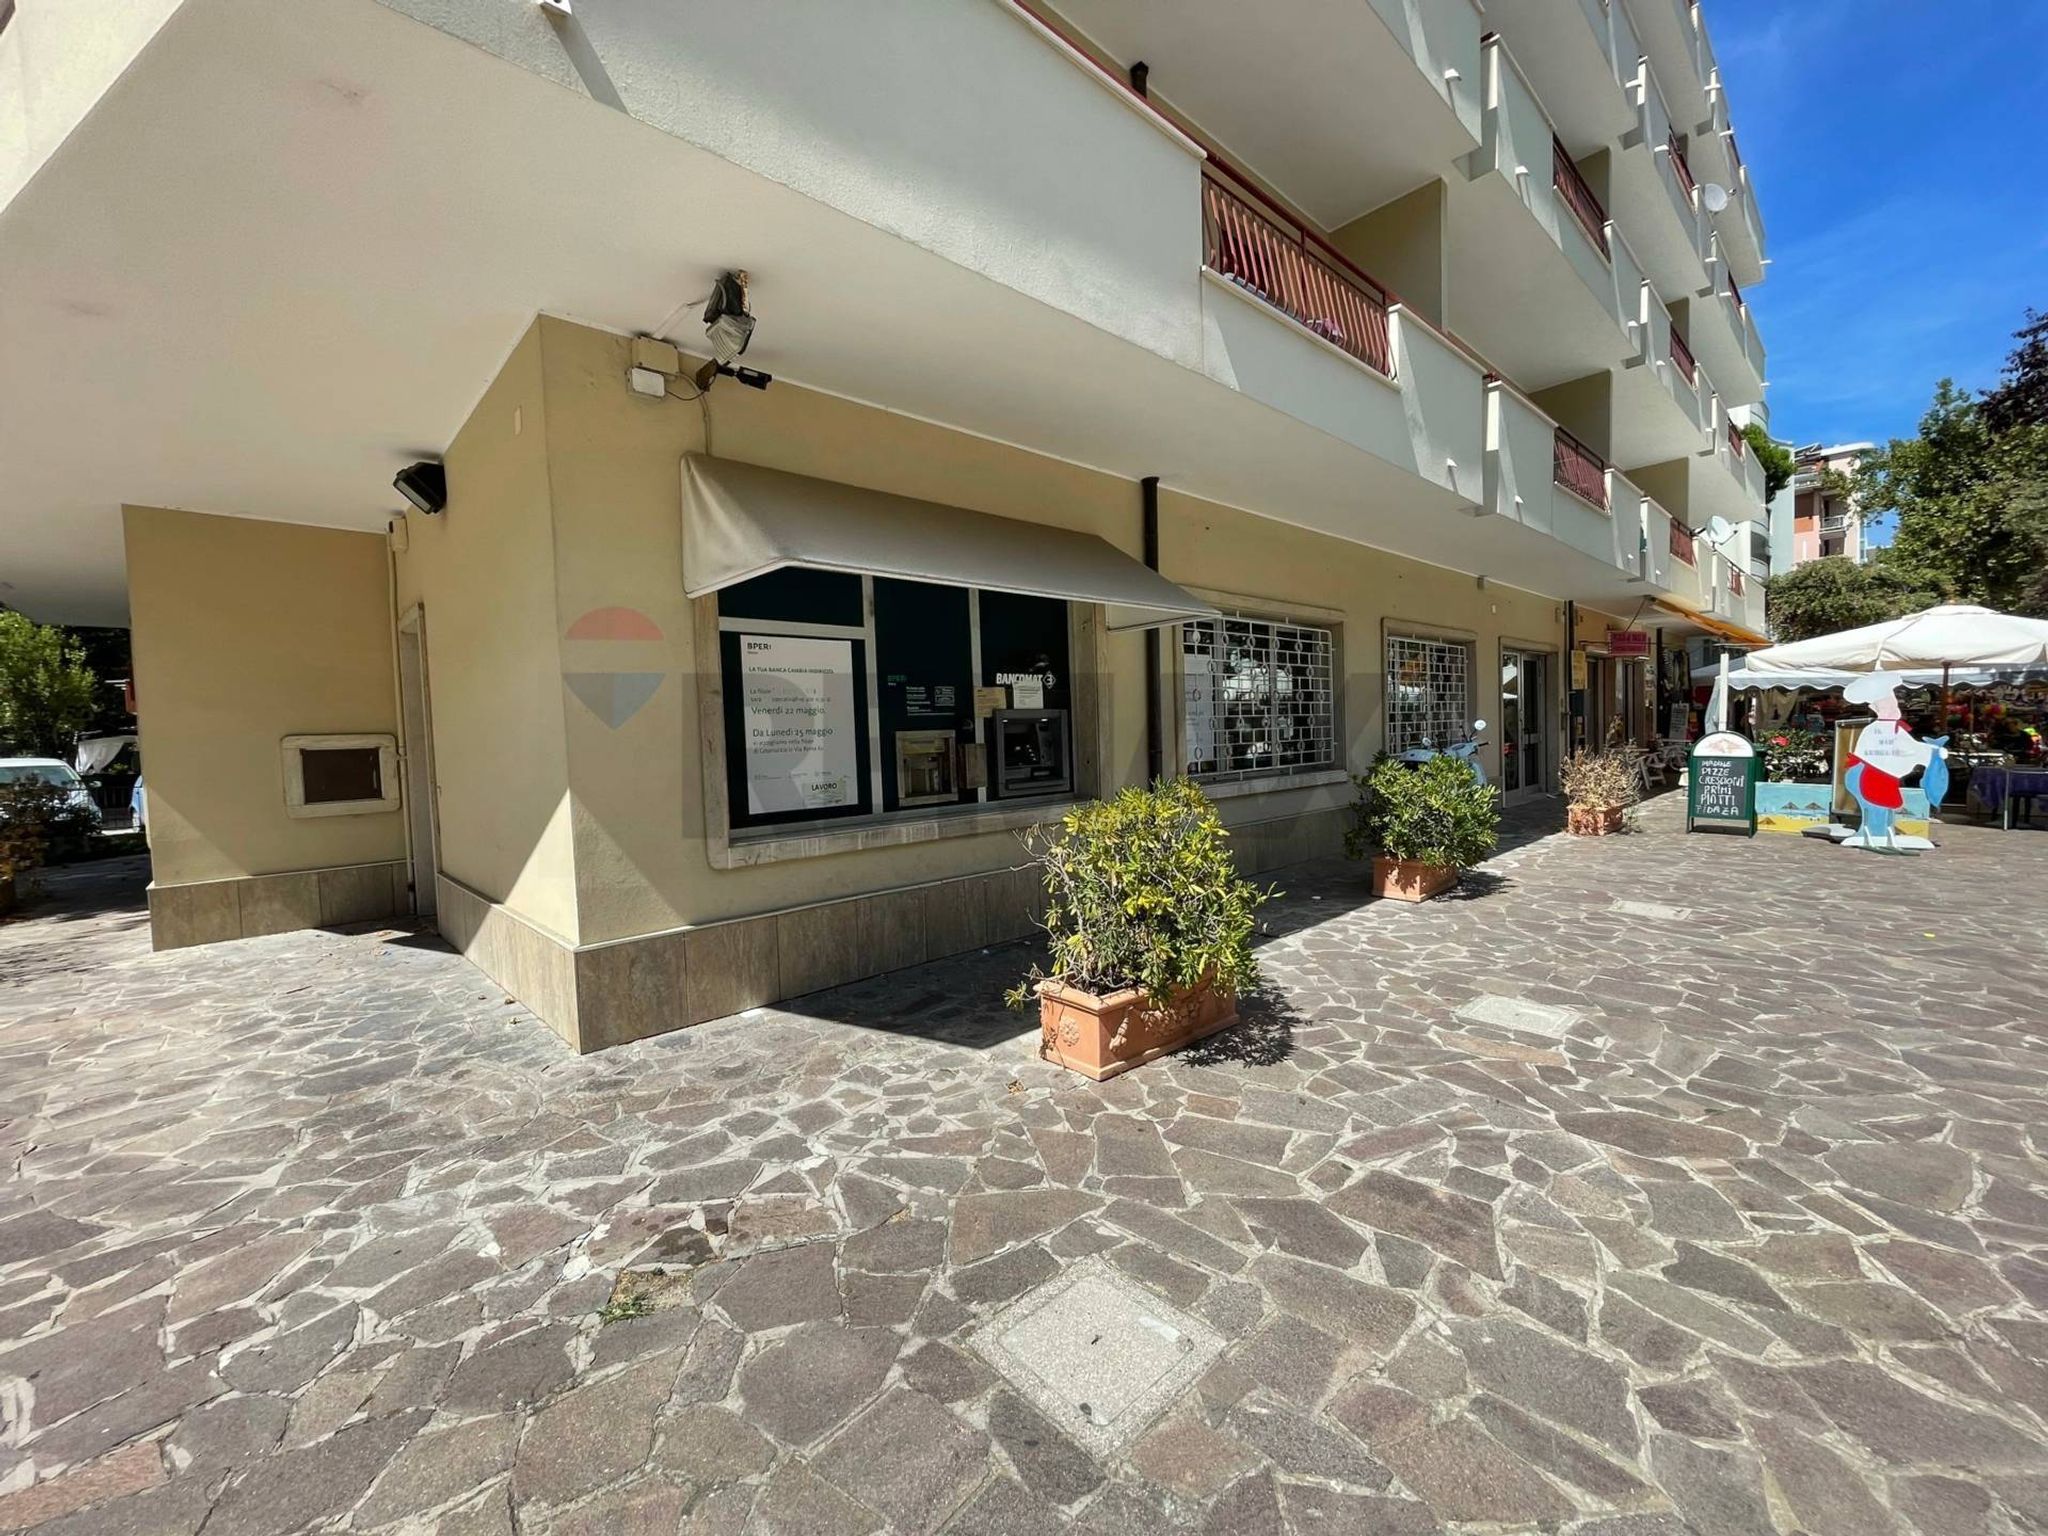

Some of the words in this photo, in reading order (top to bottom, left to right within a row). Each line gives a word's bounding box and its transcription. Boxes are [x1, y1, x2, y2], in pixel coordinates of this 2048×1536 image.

[996, 673, 1044, 685] BANCOMAT
[753, 728, 764, 737] Da
[1702, 767, 1730, 776] PIZZE
[811, 782, 838, 792] LAVORO
[1704, 784, 1732, 795] PRIMI
[1701, 793, 1735, 806] PIATTI
